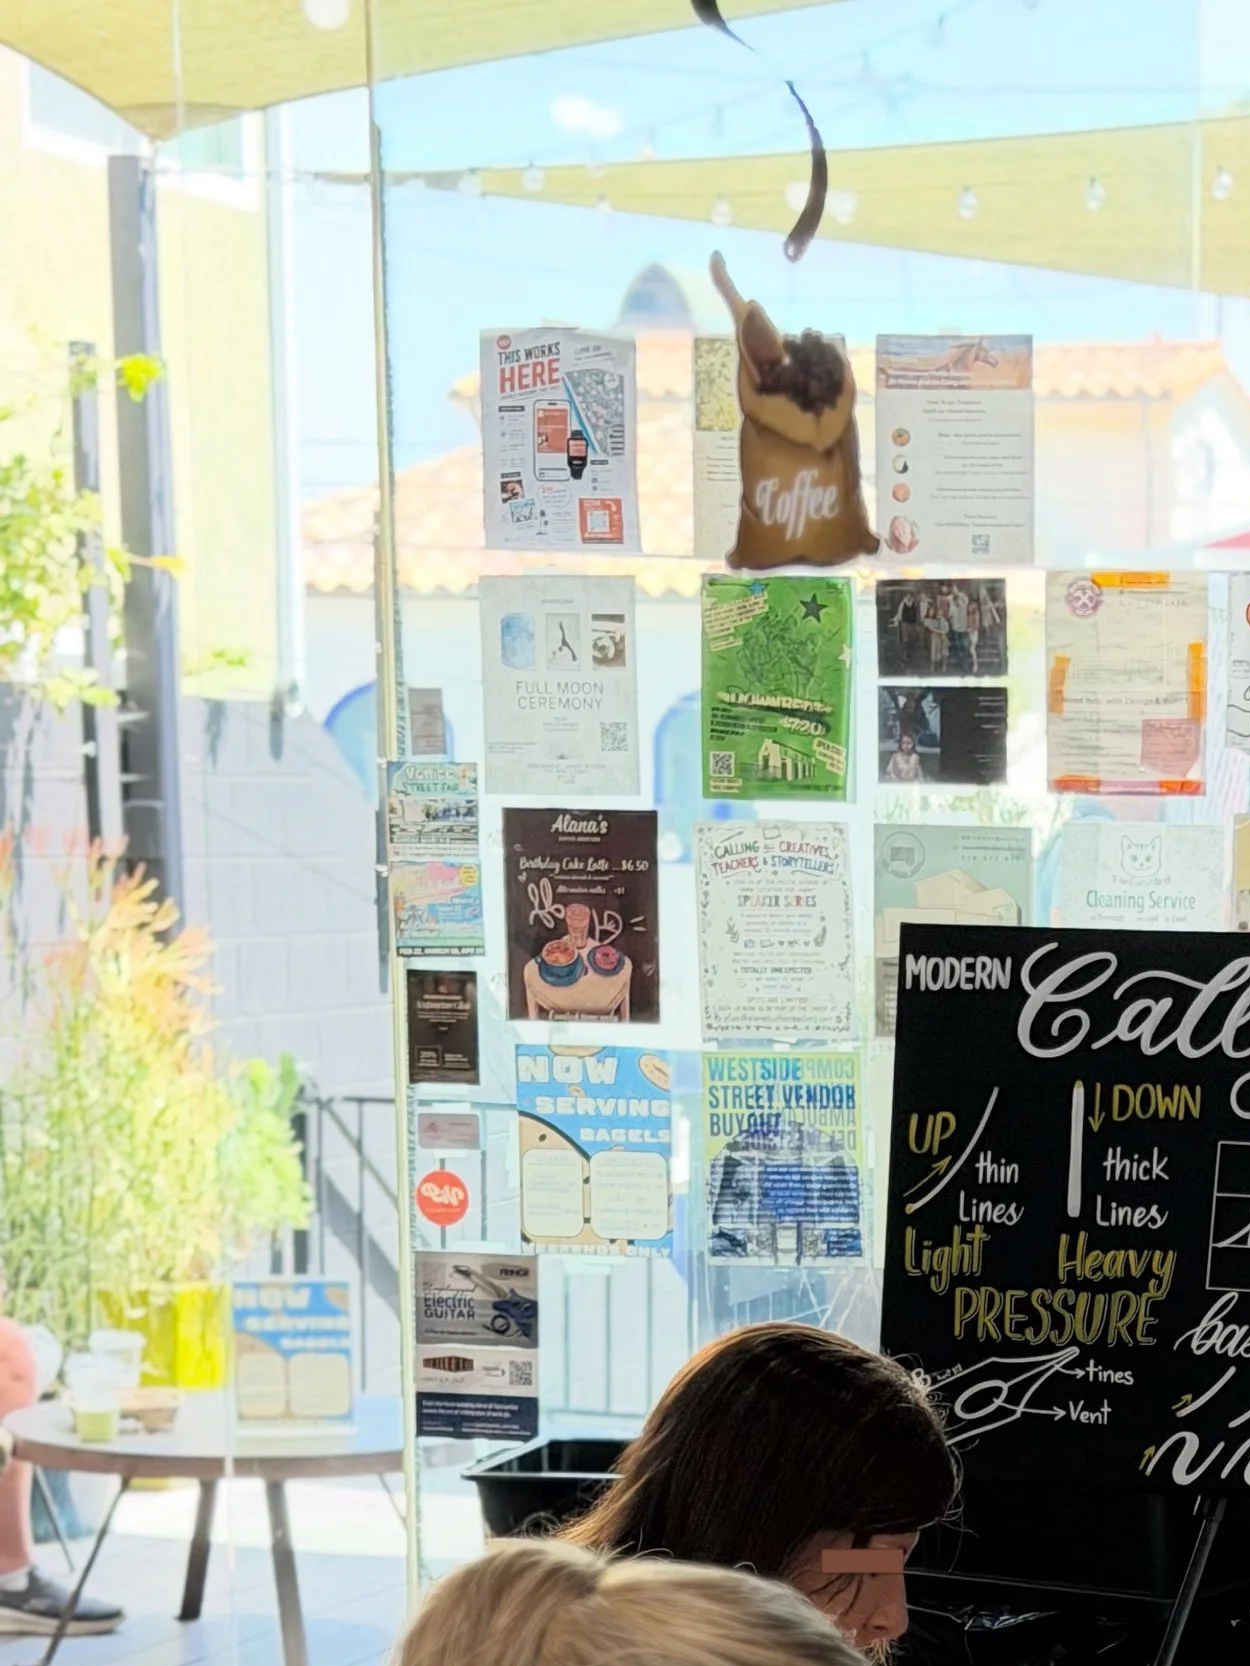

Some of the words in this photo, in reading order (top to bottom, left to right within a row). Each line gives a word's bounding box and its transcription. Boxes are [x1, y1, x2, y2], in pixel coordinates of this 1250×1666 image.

[498, 350, 521, 366] THIS
[525, 342, 561, 358] WORKS
[500, 358, 561, 394] HERE
[755, 469, 838, 542] Coffee
[516, 680, 551, 695] FULL
[557, 681, 604, 696] MOON
[517, 696, 604, 711] CEREMONY
[551, 814, 609, 834] Alana's
[714, 840, 760, 859] CALLING
[711, 857, 761, 873] TEACHERS
[1086, 890, 1145, 911] Cleaning
[1149, 890, 1196, 911] Service
[905, 954, 1012, 991] MODERN
[517, 1055, 619, 1084] NOW
[707, 1057, 801, 1082] WESTSIDE
[535, 1096, 671, 1117] SERVING
[707, 1085, 775, 1110] STREET
[783, 1084, 856, 1110] VENDOR
[1111, 1083, 1202, 1122] DOWN
[580, 1128, 671, 1144] BAGELS
[908, 1112, 957, 1155] UP
[975, 1150, 1019, 1184] thin
[1103, 1146, 1169, 1181] thick
[959, 1190, 1025, 1226] Lines
[1095, 1194, 1169, 1230] Lines
[904, 1224, 991, 1295] Light
[1058, 1231, 1178, 1300] Heavy
[424, 1292, 475, 1309] Electric
[424, 1308, 476, 1320] GUITAR
[953, 1286, 1159, 1347] PRESSURE
[1085, 1359, 1134, 1385] tines
[1069, 1399, 1112, 1425] Vent
